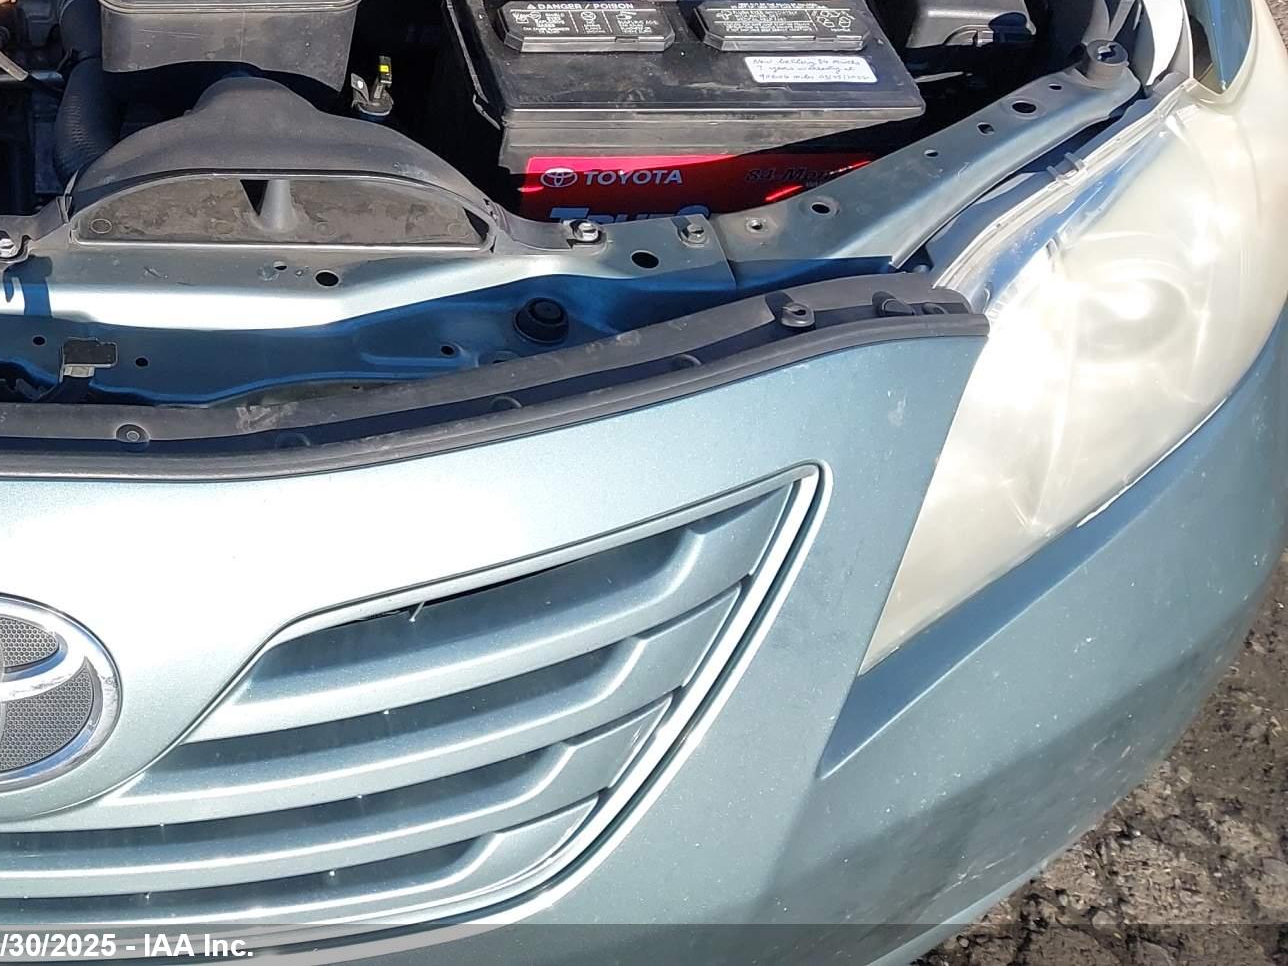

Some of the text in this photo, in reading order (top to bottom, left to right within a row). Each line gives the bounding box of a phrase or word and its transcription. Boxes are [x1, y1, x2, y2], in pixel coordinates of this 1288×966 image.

[537, 2, 583, 10] DANGER
[592, 2, 634, 10] POISON
[584, 169, 684, 186] TOYOTA
